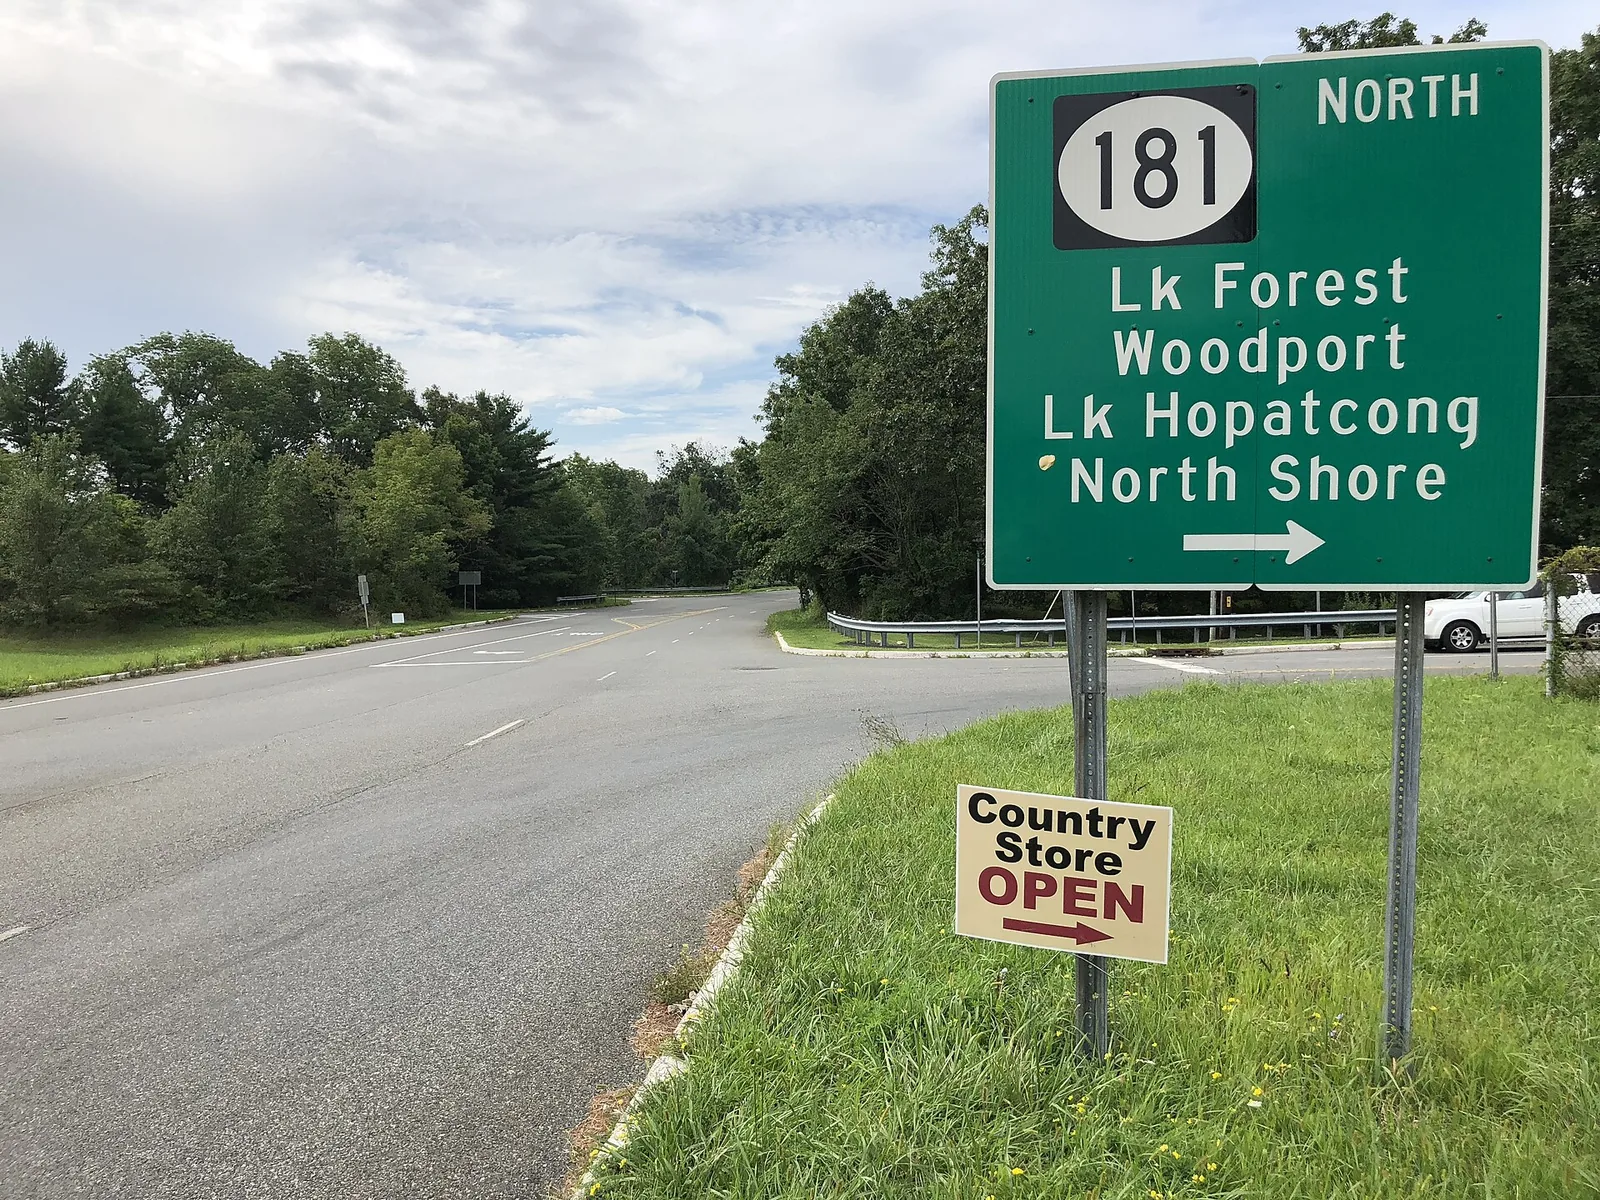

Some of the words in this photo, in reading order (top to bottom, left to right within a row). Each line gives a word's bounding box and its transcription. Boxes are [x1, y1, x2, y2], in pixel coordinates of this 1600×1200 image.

[1318, 73, 1479, 124] NORTH
[1095, 125, 1216, 210] 181
[1111, 266, 1183, 312] Lk
[1214, 257, 1408, 309] Forest
[1113, 324, 1406, 384] Woodport
[1044, 394, 1114, 440] Lk
[1145, 390, 1479, 449] Hopatcong
[1071, 456, 1237, 503] North
[1268, 454, 1446, 501] Shore
[968, 792, 1156, 850] Country
[995, 831, 1122, 875] Store
[978, 866, 1144, 923] OPEN
